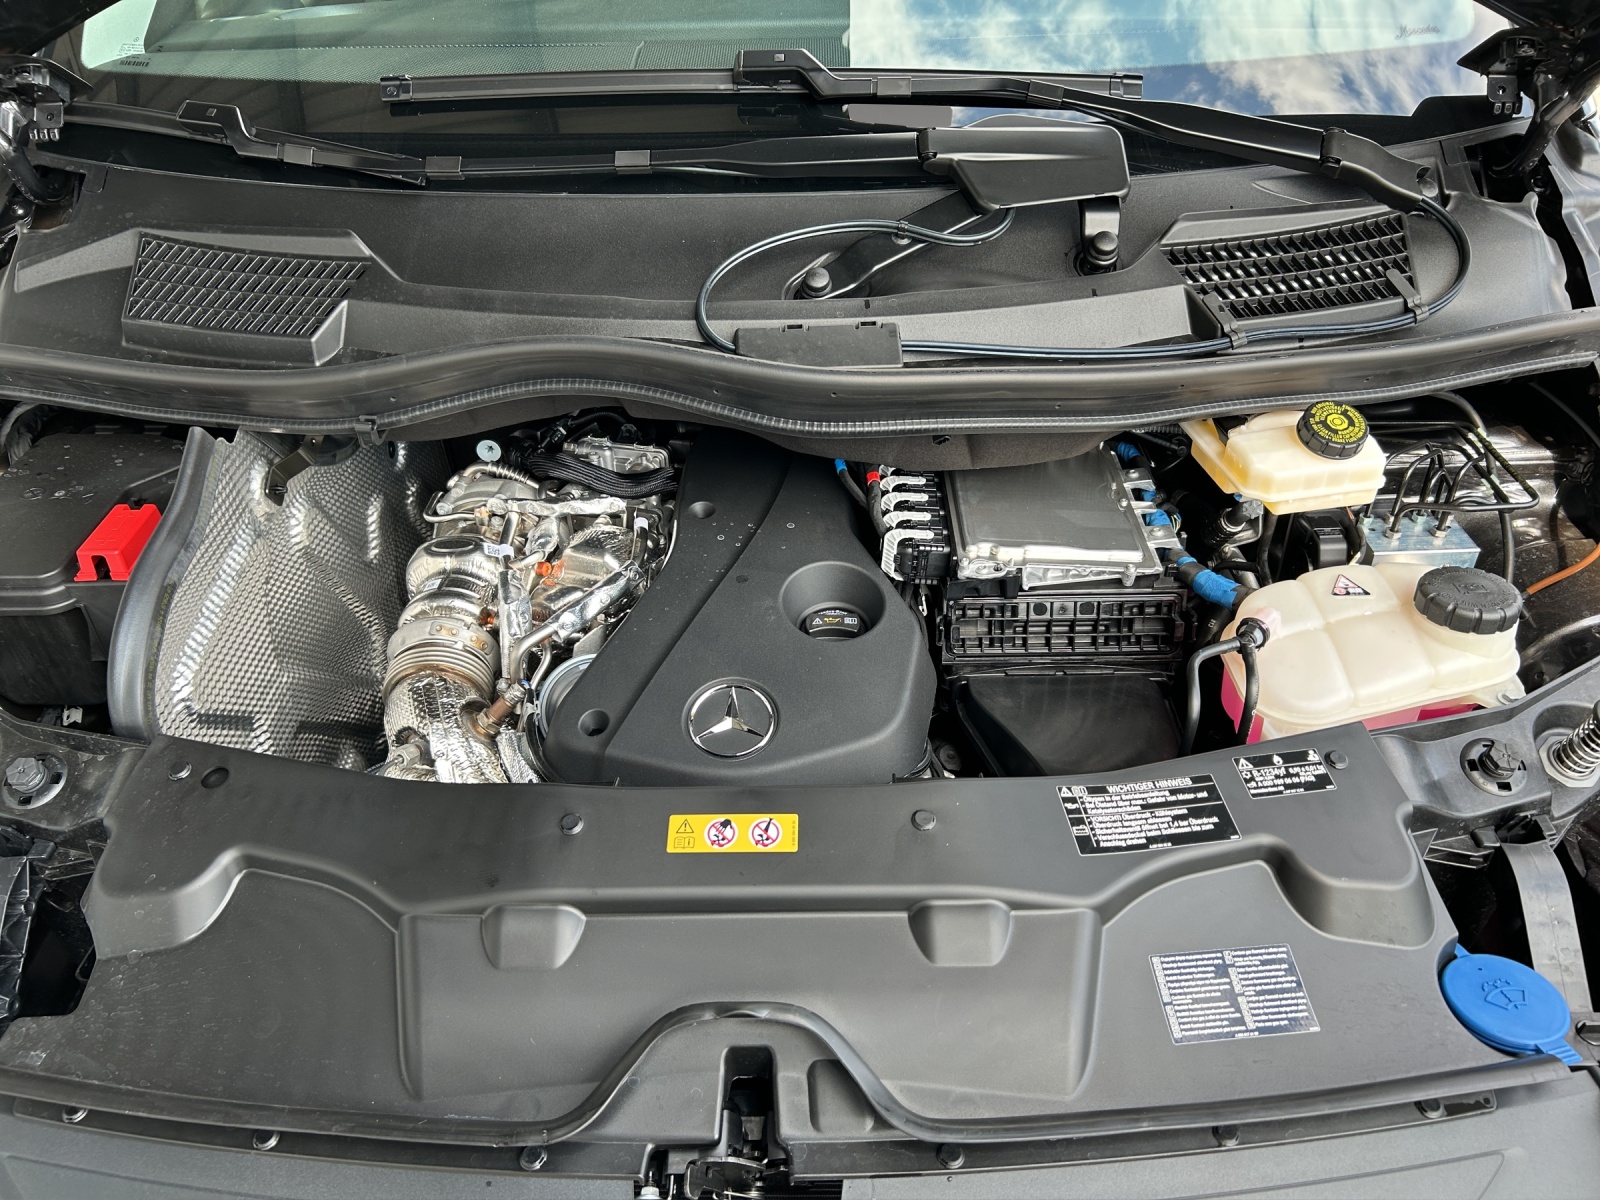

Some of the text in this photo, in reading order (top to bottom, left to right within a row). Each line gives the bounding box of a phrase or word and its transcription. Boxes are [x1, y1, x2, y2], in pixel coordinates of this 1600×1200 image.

[1395, 24, 1440, 40] Mercedes
[1252, 766, 1286, 777] R-1234yf
[1106, 777, 1192, 793] WICHTIGER HINWEIS
